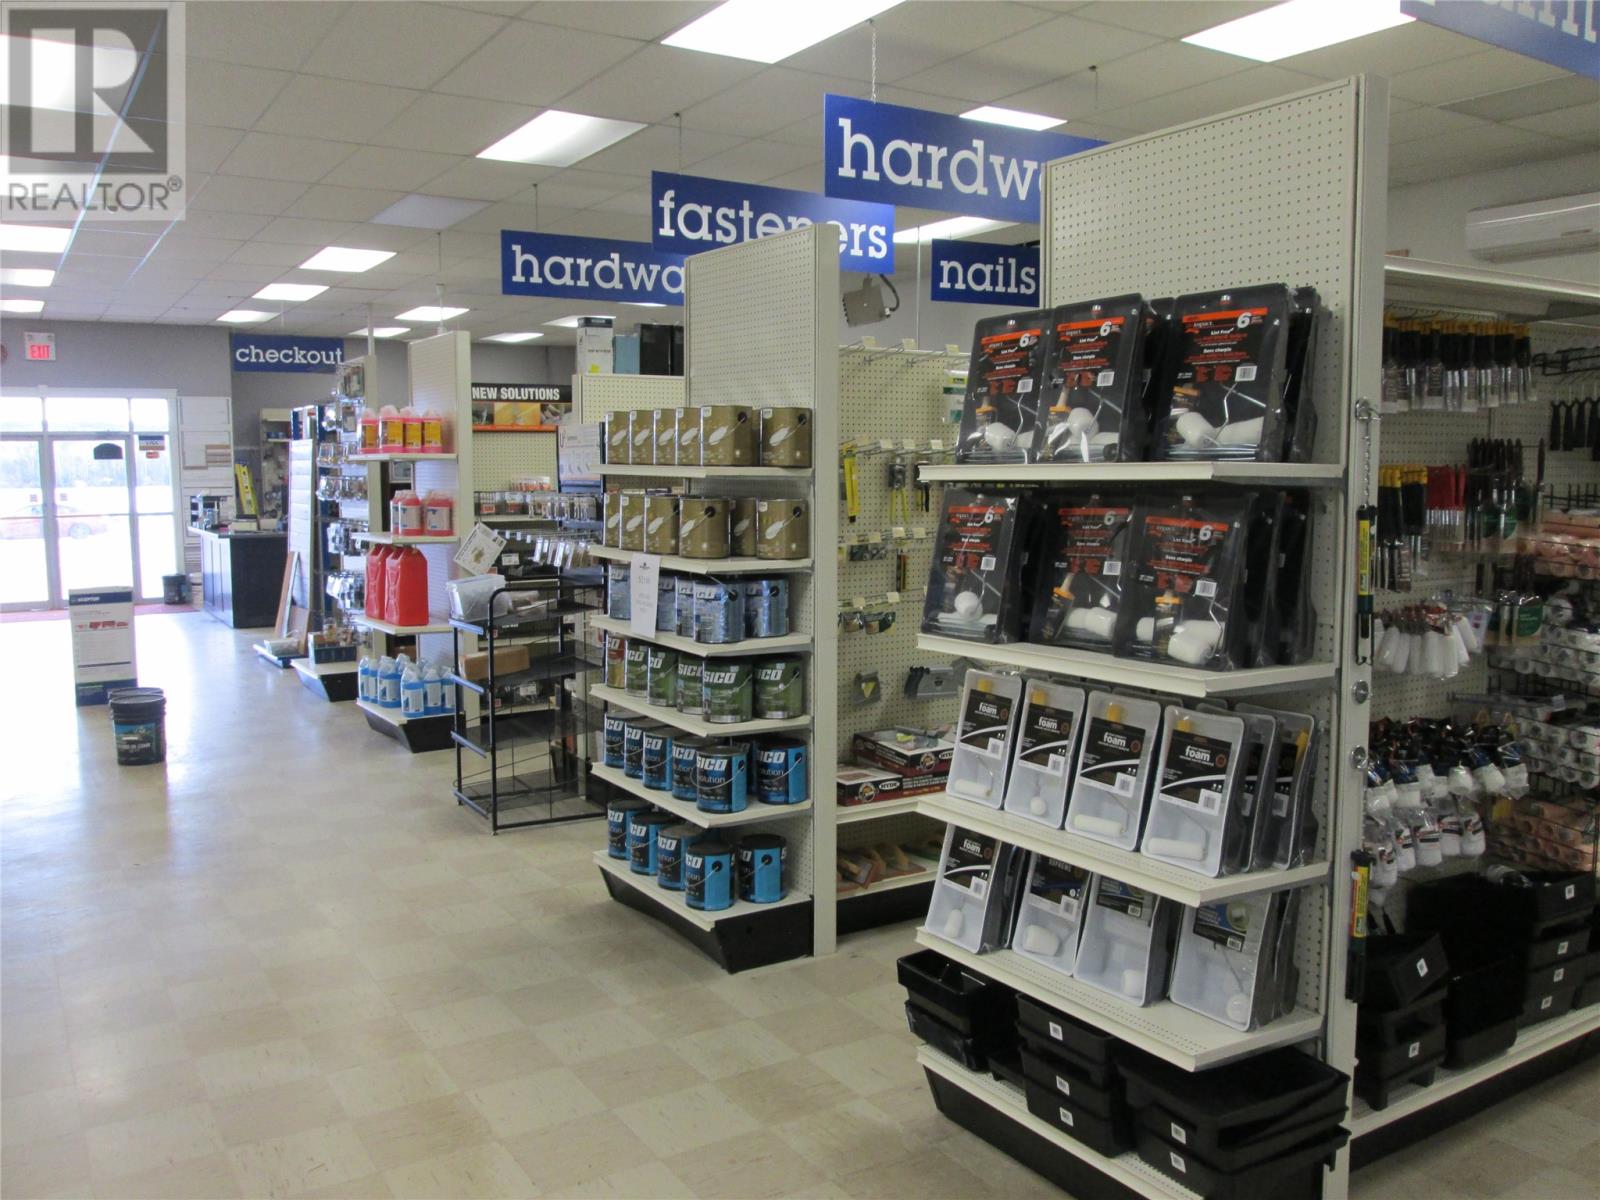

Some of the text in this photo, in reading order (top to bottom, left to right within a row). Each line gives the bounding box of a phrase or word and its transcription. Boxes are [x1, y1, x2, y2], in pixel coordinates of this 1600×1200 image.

[838, 117, 1042, 201] hardw
[939, 257, 1036, 295] nails
[1237, 312, 1252, 328] 6
[235, 345, 344, 365] checkout
[472, 387, 560, 401] NEW SOLUTIONS
[702, 670, 737, 684] SICO
[1103, 731, 1127, 747] foam
[1184, 745, 1211, 762] foam
